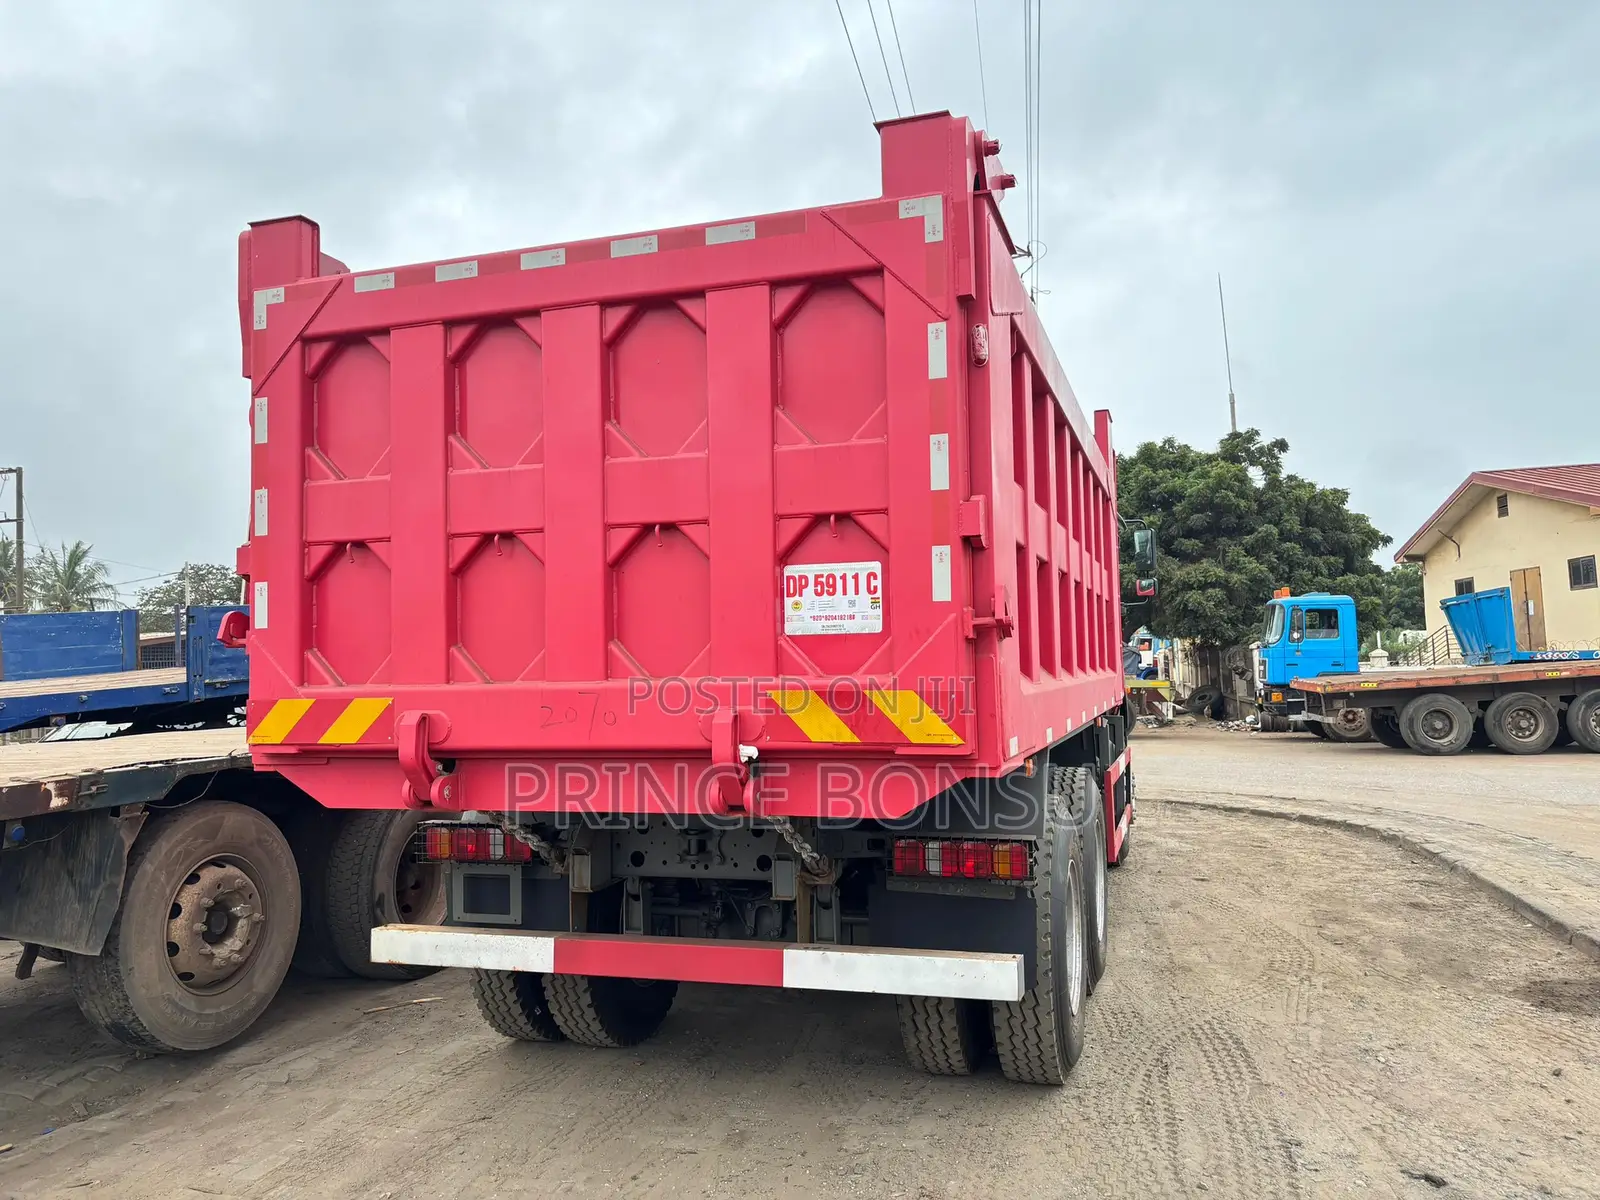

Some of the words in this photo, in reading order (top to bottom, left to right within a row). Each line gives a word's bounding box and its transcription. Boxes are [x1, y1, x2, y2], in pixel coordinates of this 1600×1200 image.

[786, 575, 809, 598] DP
[814, 572, 860, 597] 5911
[866, 571, 878, 595] C
